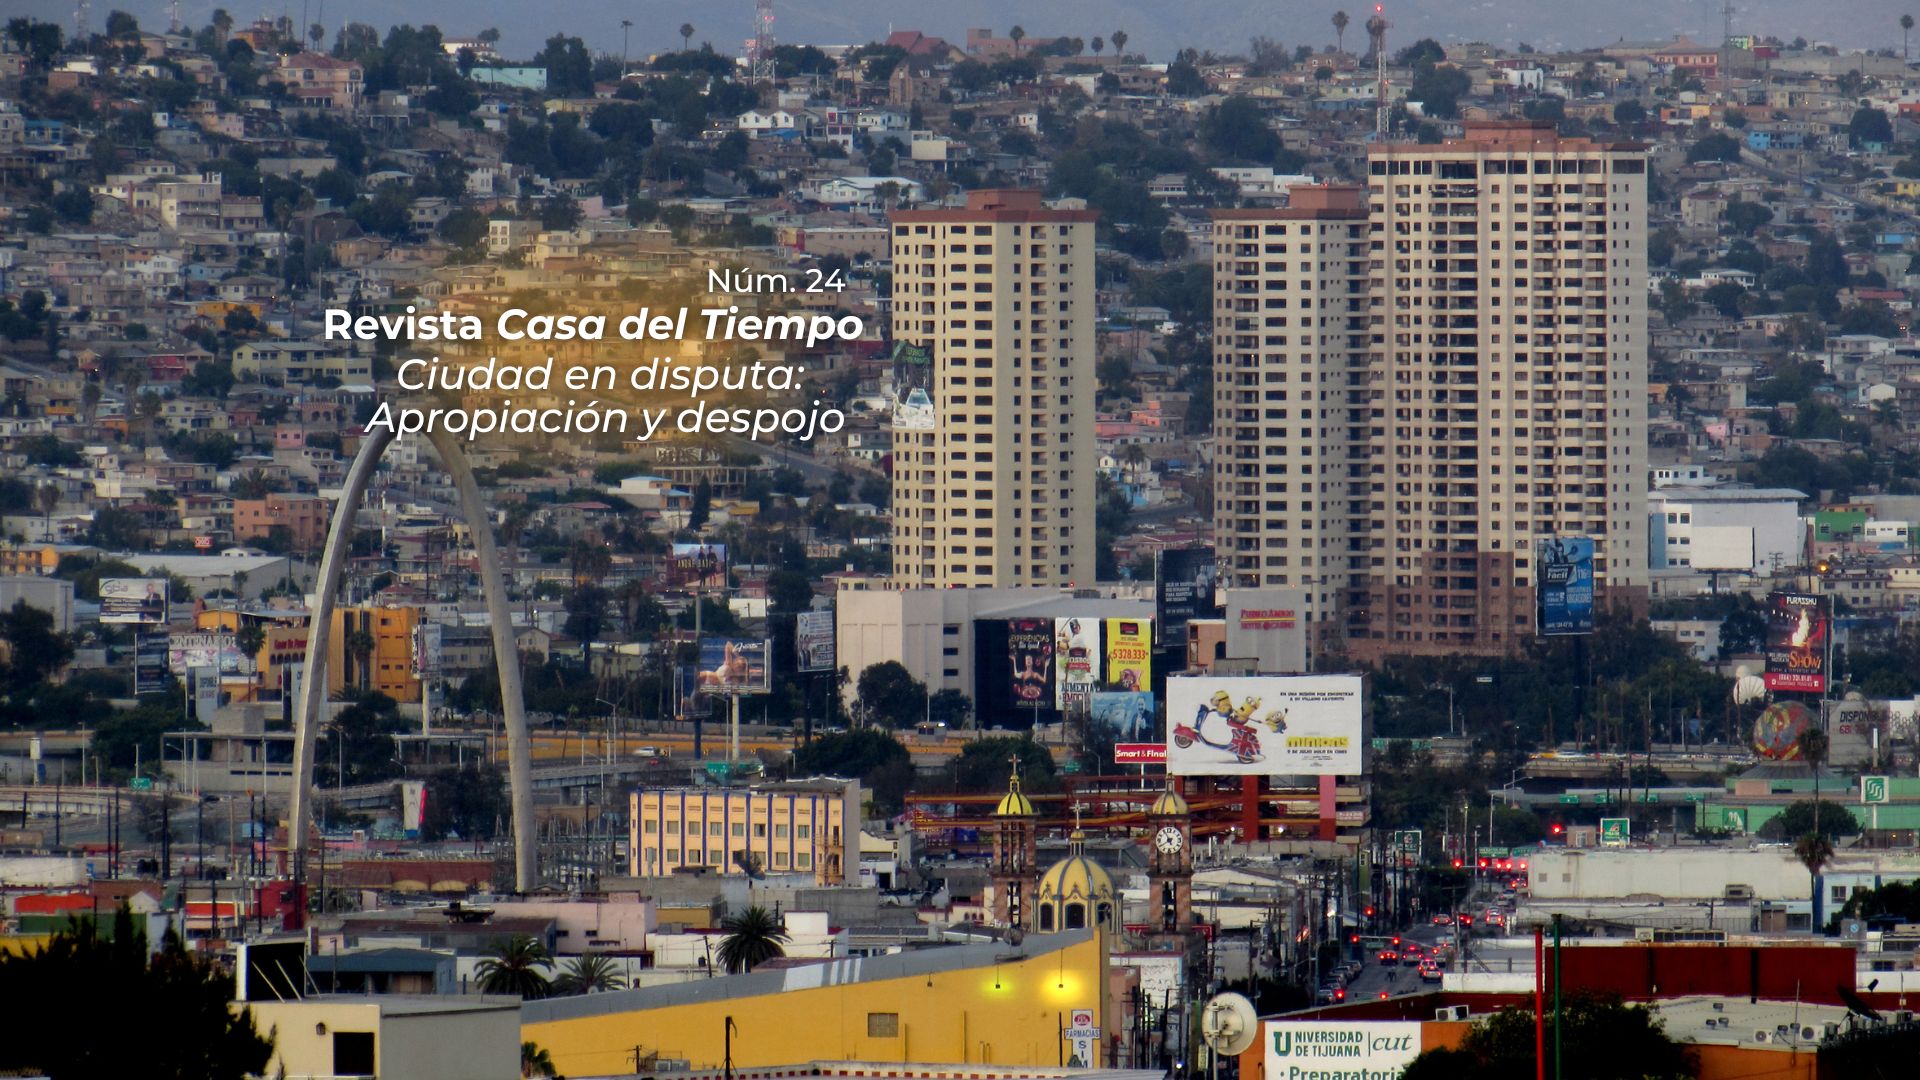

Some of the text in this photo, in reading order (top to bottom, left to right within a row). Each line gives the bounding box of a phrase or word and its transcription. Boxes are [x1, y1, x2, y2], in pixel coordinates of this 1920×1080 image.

[1115, 750, 1140, 758] Smart
[1146, 749, 1167, 758] Final
[1066, 1029, 1100, 1038] FARMACIAS
[1372, 1033, 1413, 1051] cut
[1295, 1045, 1361, 1057] DE TIJUANA
